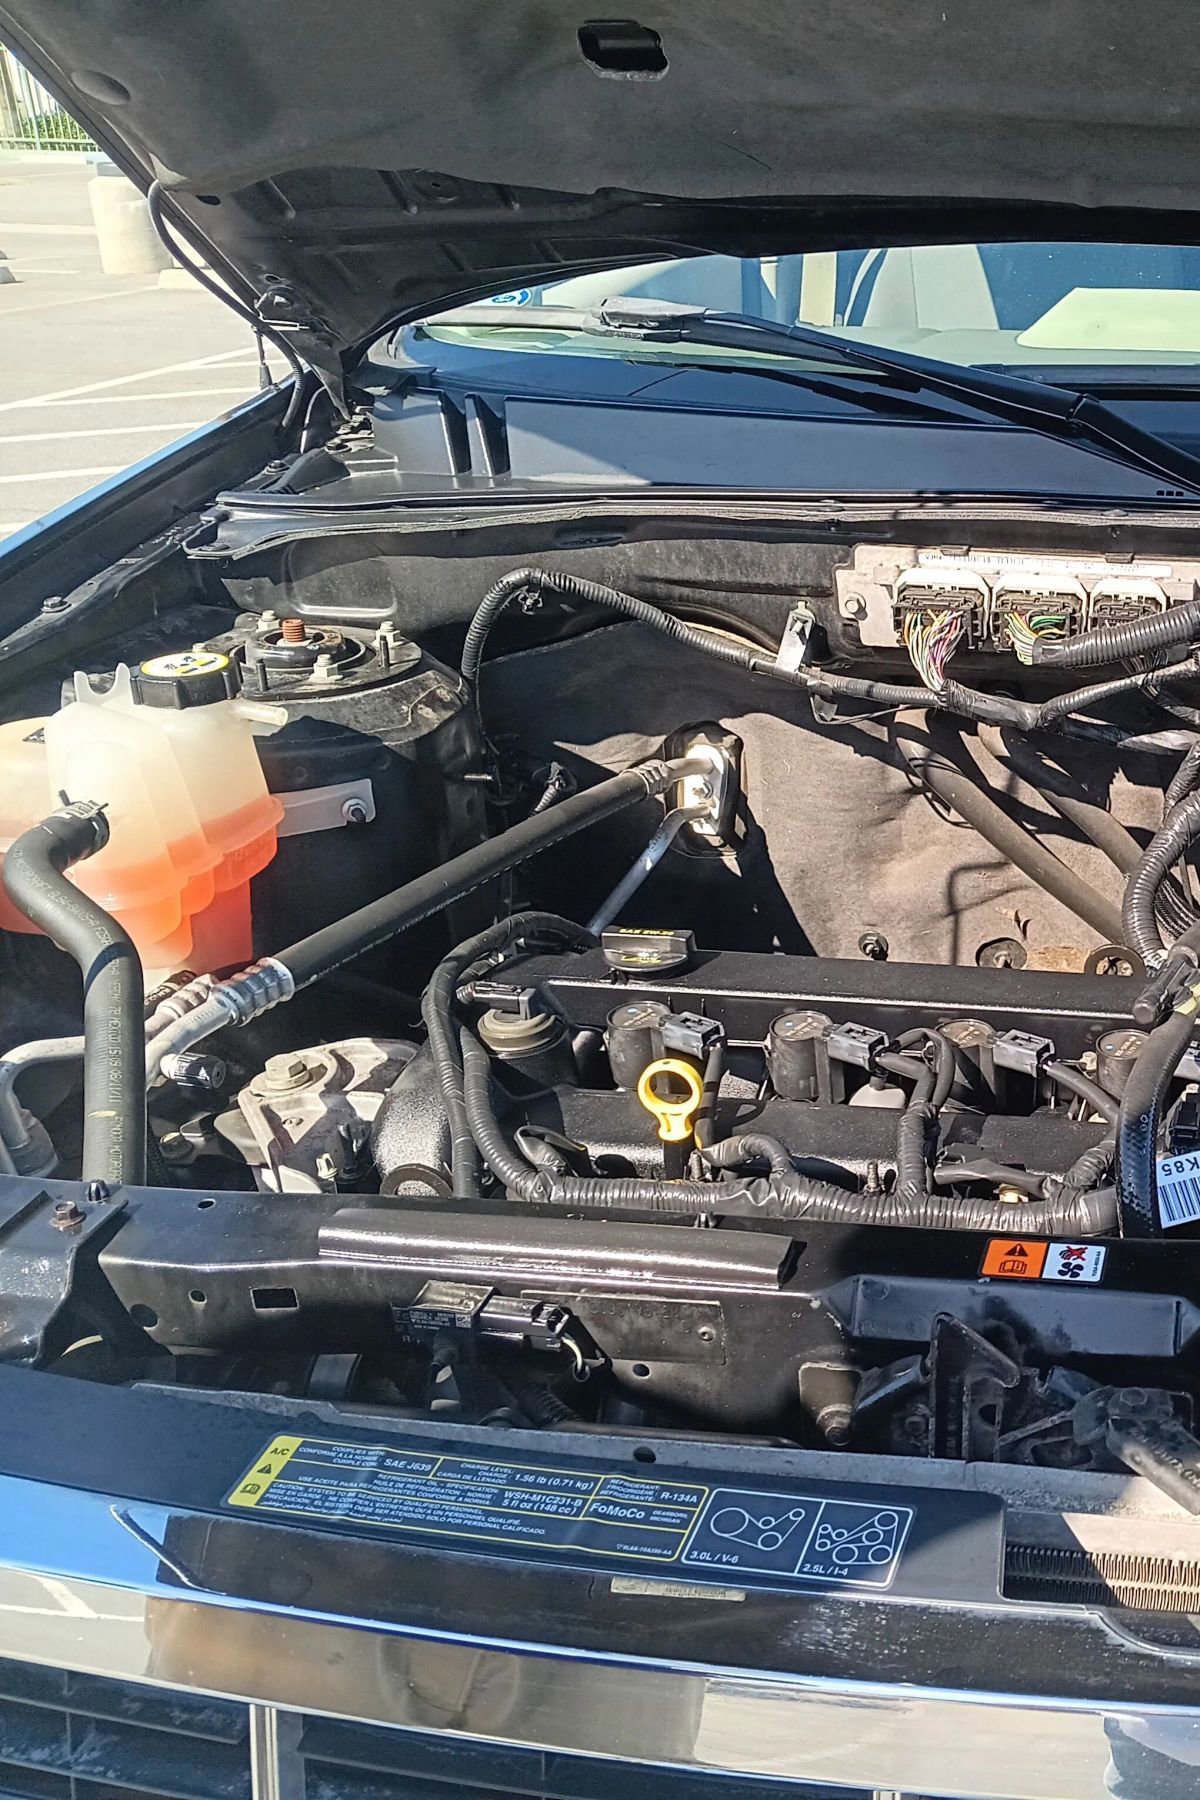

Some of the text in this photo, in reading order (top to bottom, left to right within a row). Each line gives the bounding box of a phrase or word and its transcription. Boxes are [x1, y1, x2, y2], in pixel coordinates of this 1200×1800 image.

[1161, 1156, 1200, 1177] K85
[270, 1447, 290, 1456] A/C
[383, 1458, 431, 1471] SAE J639
[460, 1462, 514, 1474] CHARGE LEVEL:
[377, 1474, 427, 1484] REFRIGERANT
[436, 1471, 461, 1479] CARGA
[478, 1470, 508, 1479] CHARGE
[373, 1479, 395, 1487] HUILE
[515, 1474, 594, 1491] 1.56 lb (0.71 kg)
[503, 1490, 583, 1507] WSH-M1C231-B
[660, 1491, 698, 1504] R-134A
[510, 1499, 520, 1507] fl
[533, 1501, 557, 1512] (148
[557, 1505, 577, 1516] cc)
[589, 1502, 646, 1519] FoMoCo
[462, 1519, 502, 1530] PERSONAL
[689, 1550, 711, 1561] 3.0L
[721, 1554, 739, 1563] V-6
[802, 1563, 825, 1574] 2.5L
[834, 1567, 849, 1576] I-4
